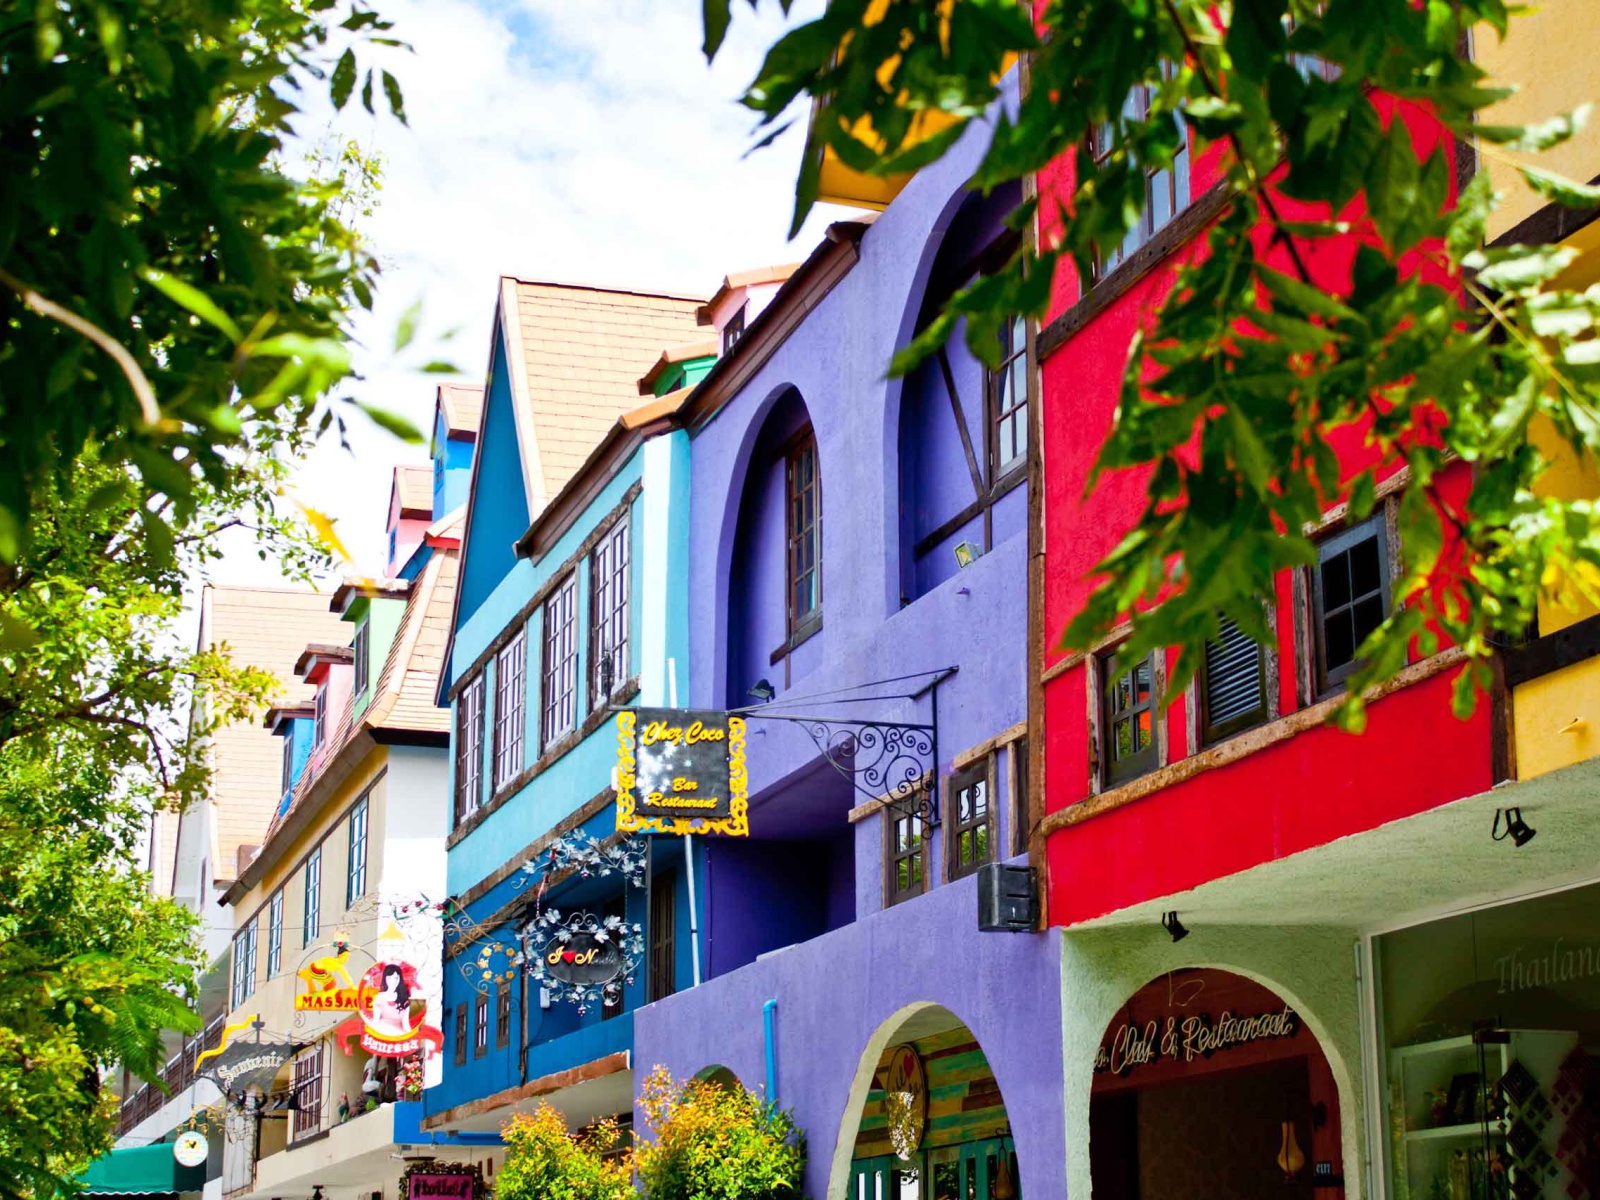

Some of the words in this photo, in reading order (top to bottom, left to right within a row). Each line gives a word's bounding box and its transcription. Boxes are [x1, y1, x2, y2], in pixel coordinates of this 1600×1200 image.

[643, 720, 682, 746] Chez
[684, 720, 725, 745] Coco
[672, 777, 699, 792] Bar
[647, 791, 719, 808] Restaurant
[1161, 1016, 1178, 1060] &
[1181, 1002, 1295, 1062] Restaurant
[217, 1050, 284, 1090] Souvenir
